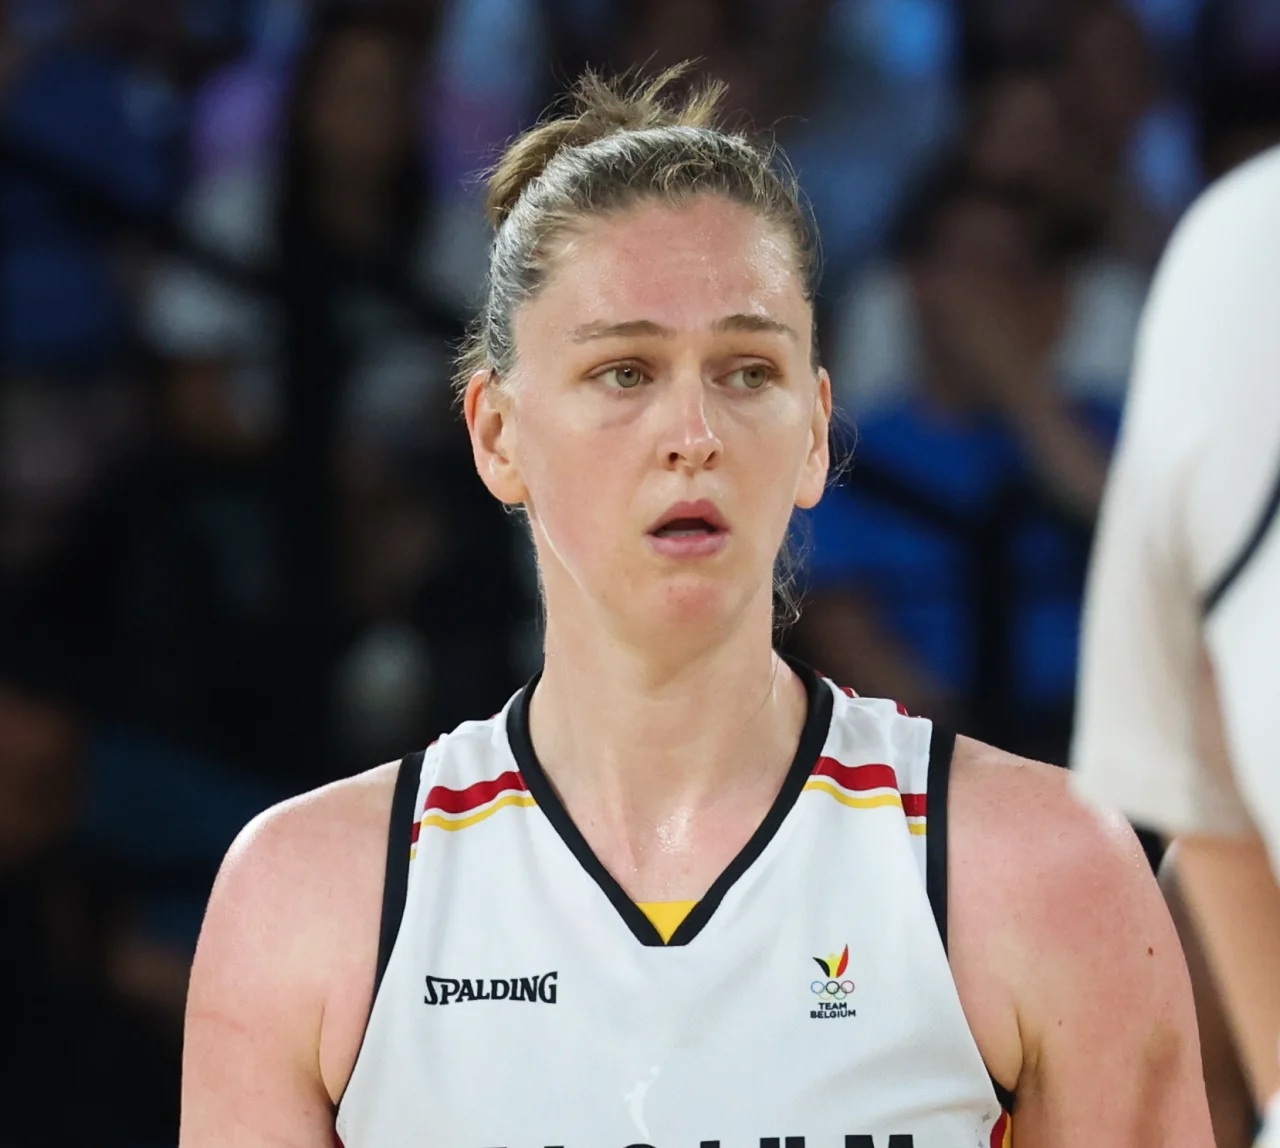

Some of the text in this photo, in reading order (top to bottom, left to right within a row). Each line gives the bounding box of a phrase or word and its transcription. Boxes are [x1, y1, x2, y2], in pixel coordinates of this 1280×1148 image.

[424, 971, 558, 1005] SPALDING
[818, 1002, 847, 1010] TEAM
[810, 1009, 856, 1019] BELGIUM
